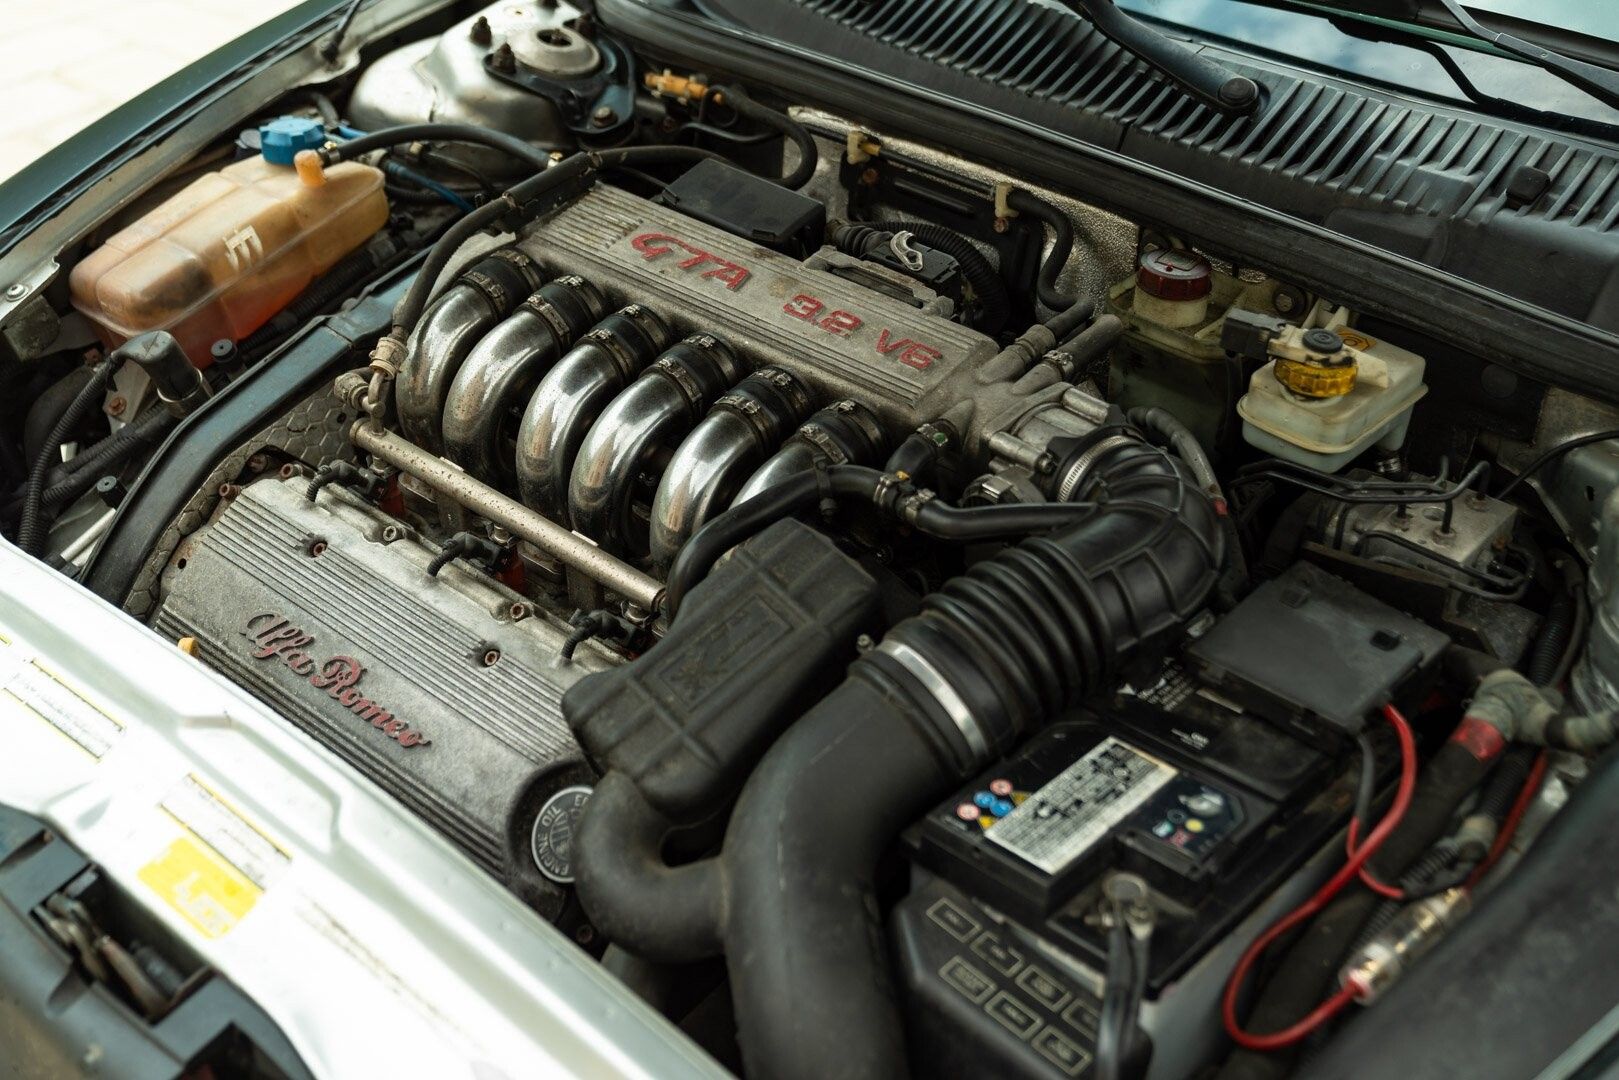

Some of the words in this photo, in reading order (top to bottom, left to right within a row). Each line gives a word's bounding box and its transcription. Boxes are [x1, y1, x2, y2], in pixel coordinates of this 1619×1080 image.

[631, 233, 751, 292] GTA
[783, 293, 863, 338] 3.2
[875, 328, 943, 370] V6
[239, 613, 316, 676] Alfa
[309, 655, 432, 748] Romeo
[537, 832, 570, 877] ENGINE
[541, 805, 561, 827] OIL
